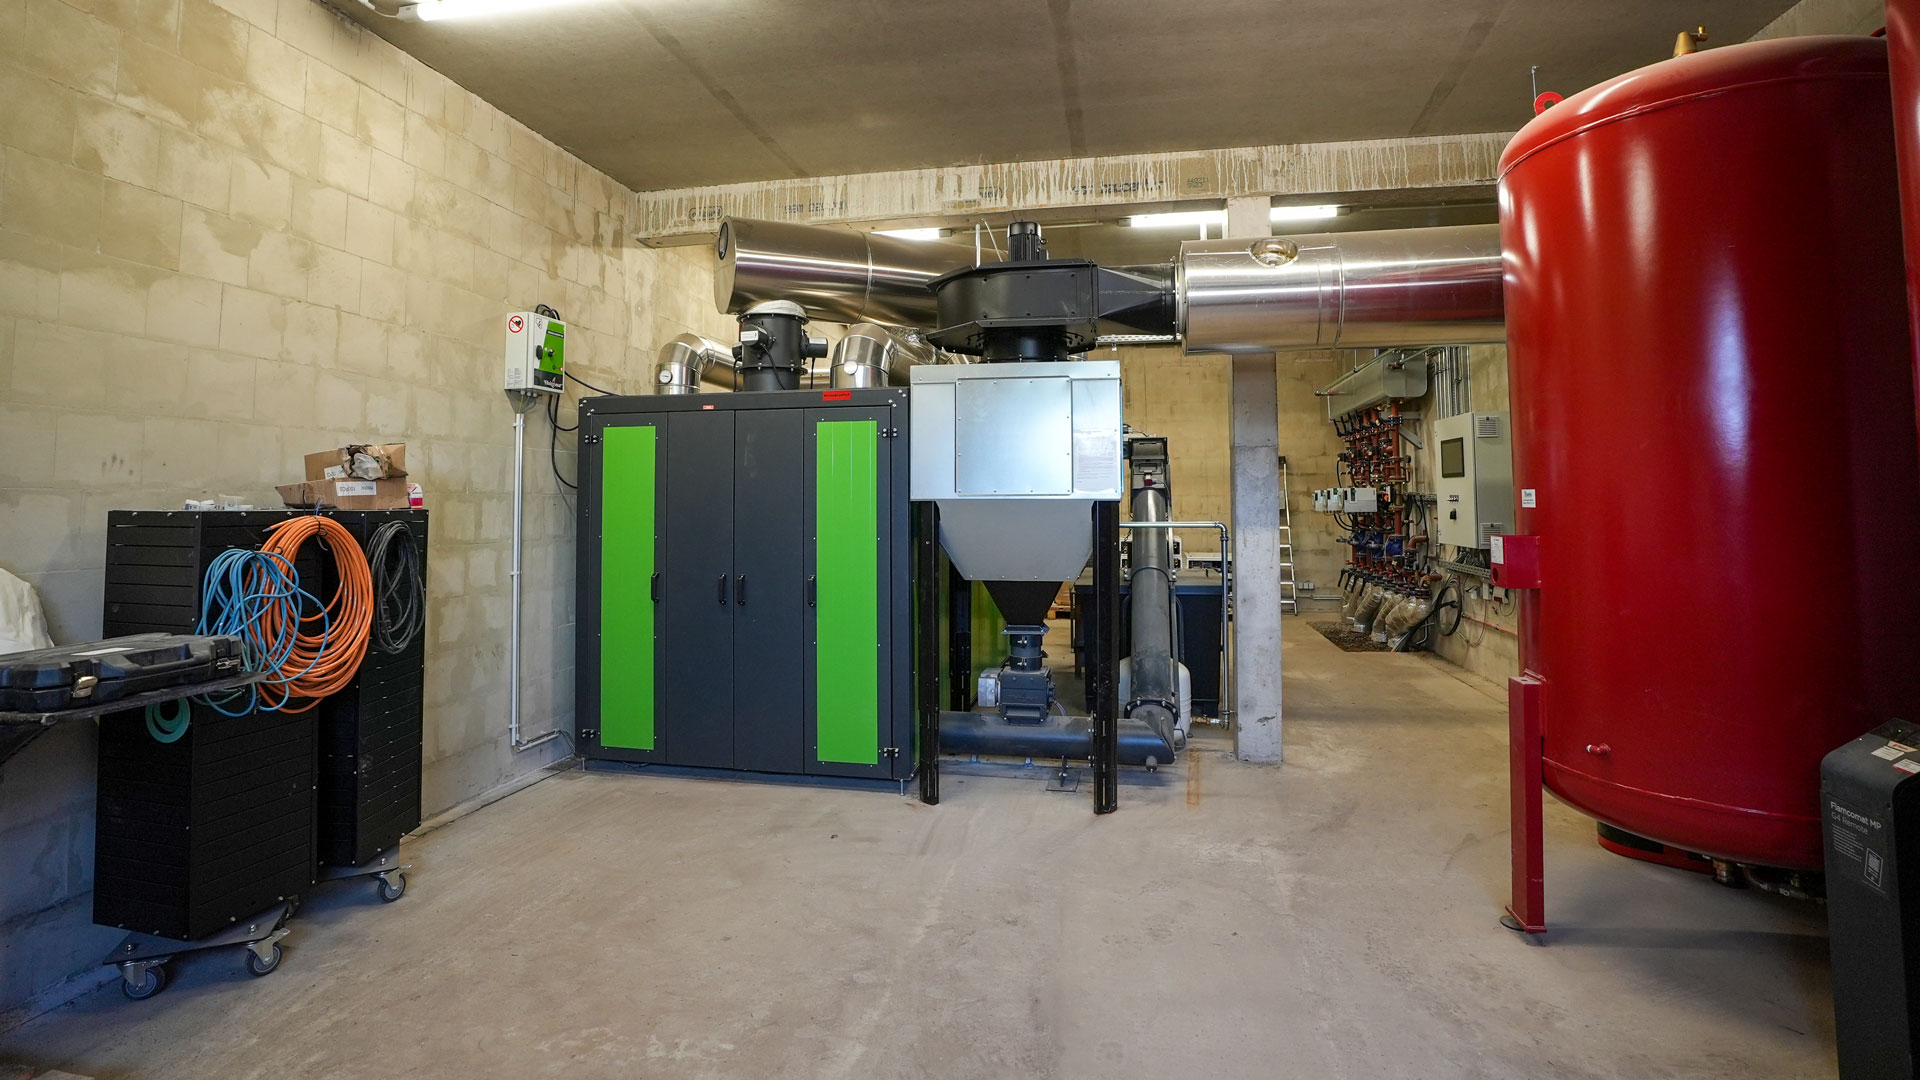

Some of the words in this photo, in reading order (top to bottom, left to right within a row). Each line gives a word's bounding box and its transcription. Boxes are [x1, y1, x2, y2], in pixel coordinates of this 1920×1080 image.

[1830, 801, 1869, 825] Flamcomat
[1869, 819, 1882, 830] MP
[1842, 816, 1868, 835] Remote
